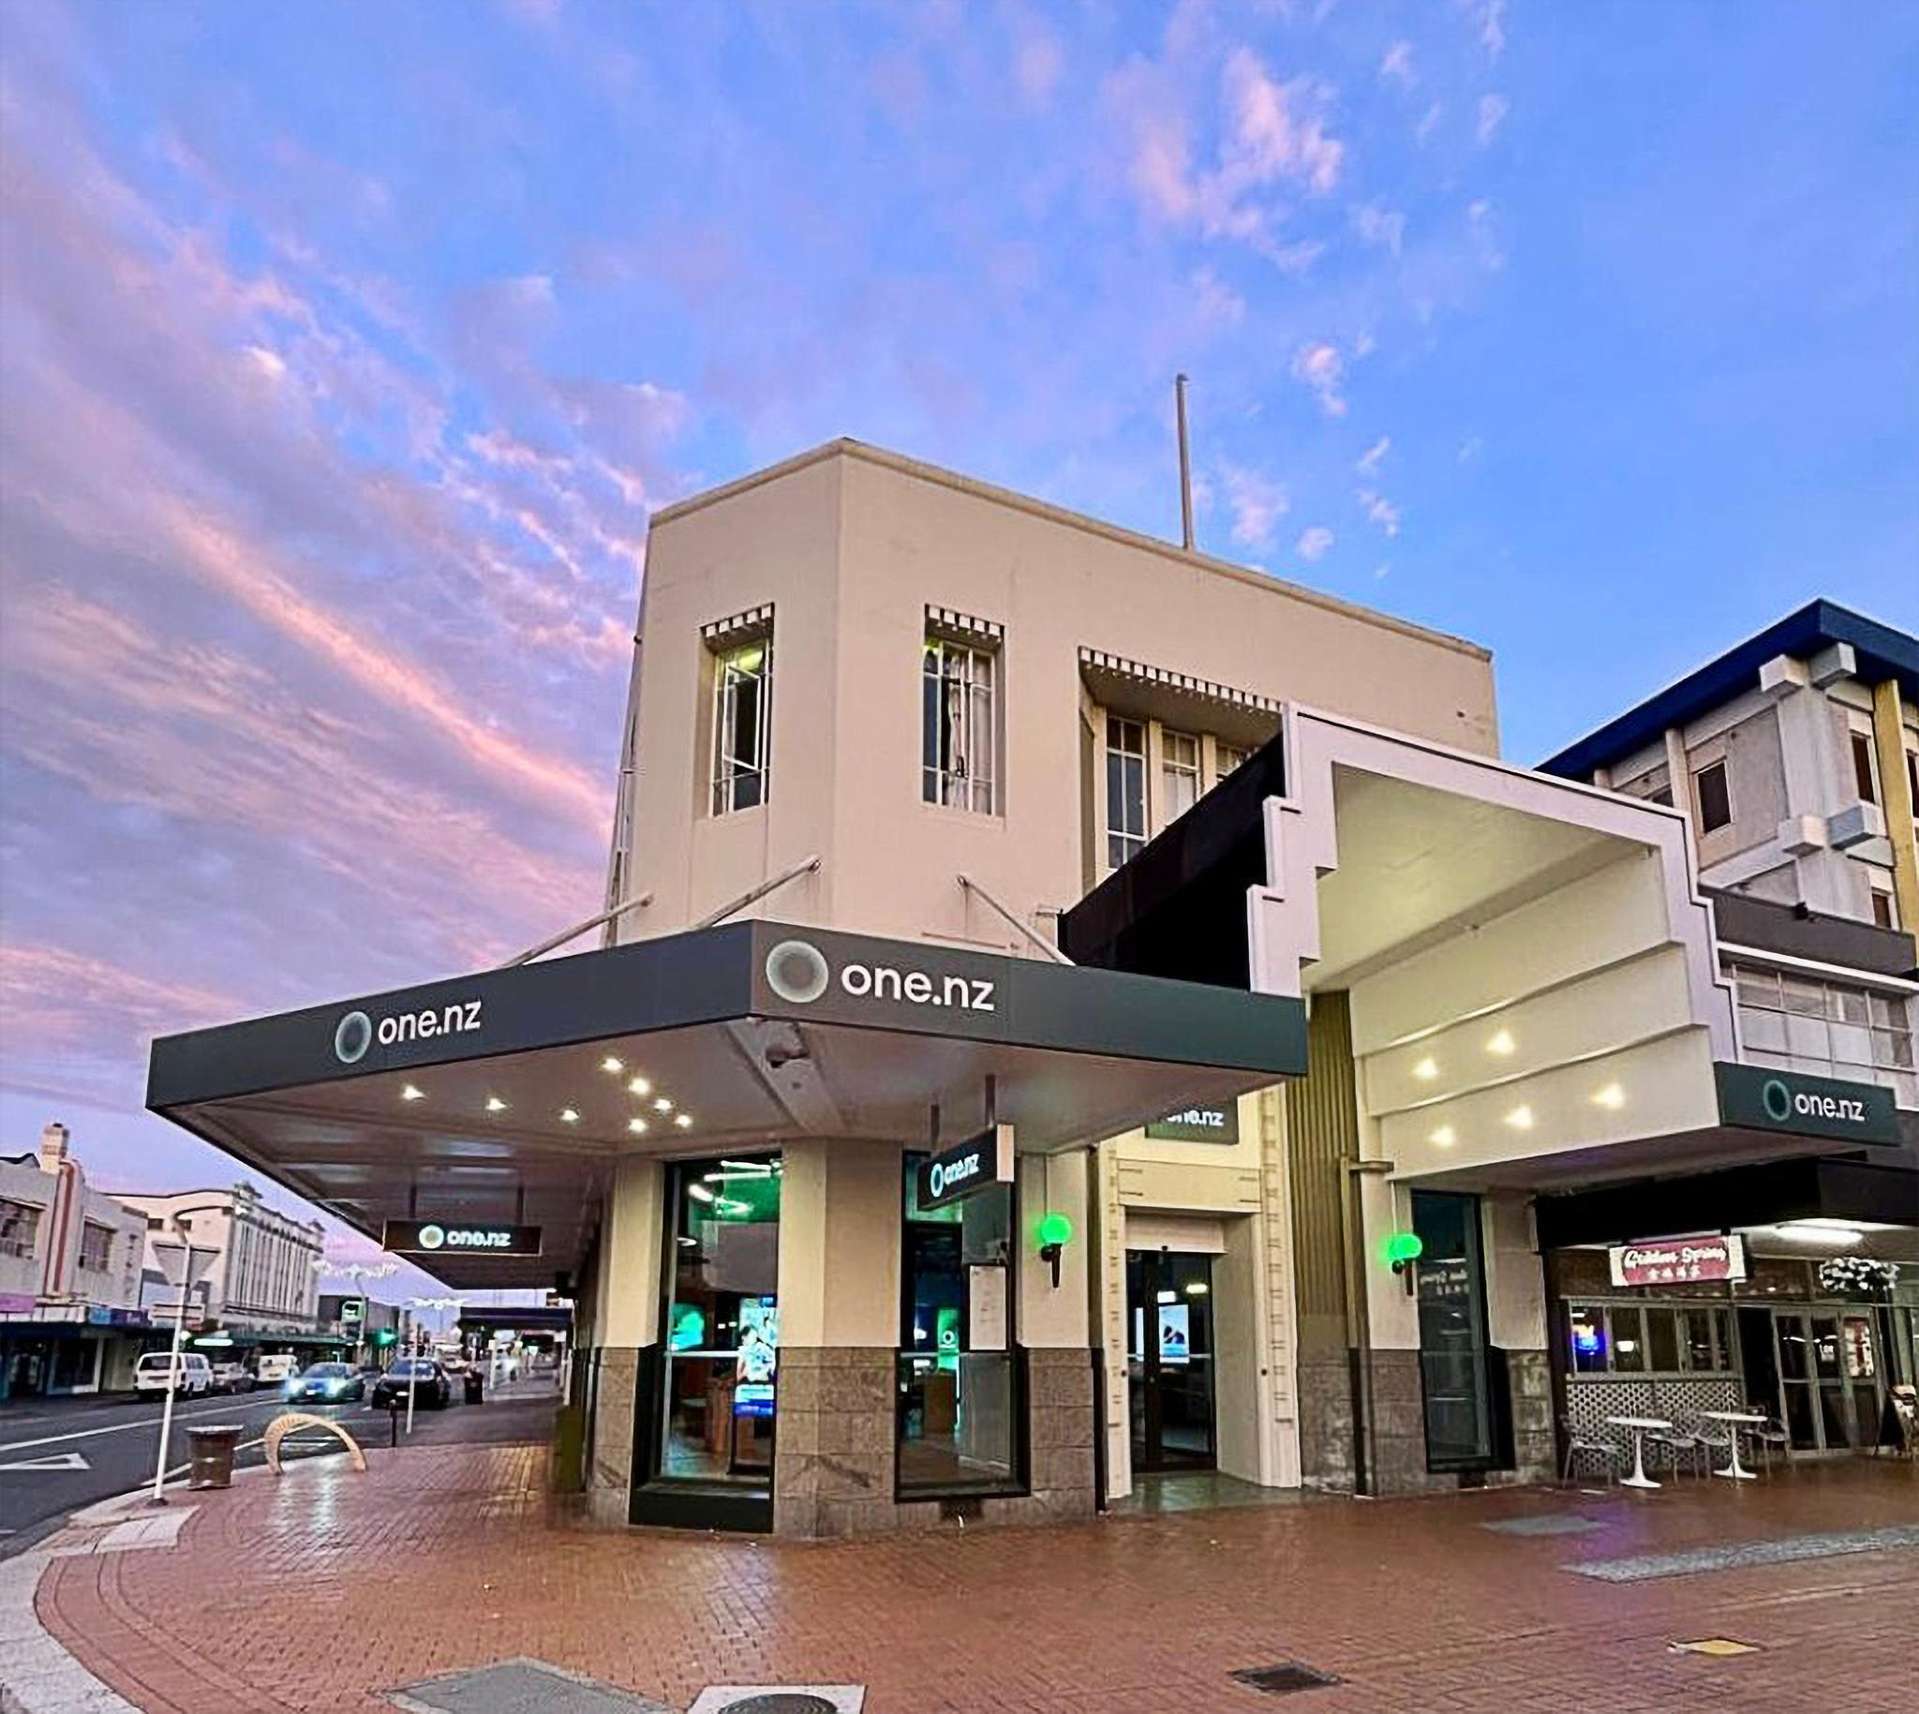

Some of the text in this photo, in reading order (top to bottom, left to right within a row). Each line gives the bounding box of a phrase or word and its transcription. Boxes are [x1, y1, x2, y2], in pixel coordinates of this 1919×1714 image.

[841, 964, 995, 1011] one.nz
[377, 1001, 482, 1045] one.nz
[1794, 1093, 1865, 1121] one.nz
[944, 1153, 980, 1185] one.nz
[447, 1230, 511, 1247] one.nz
